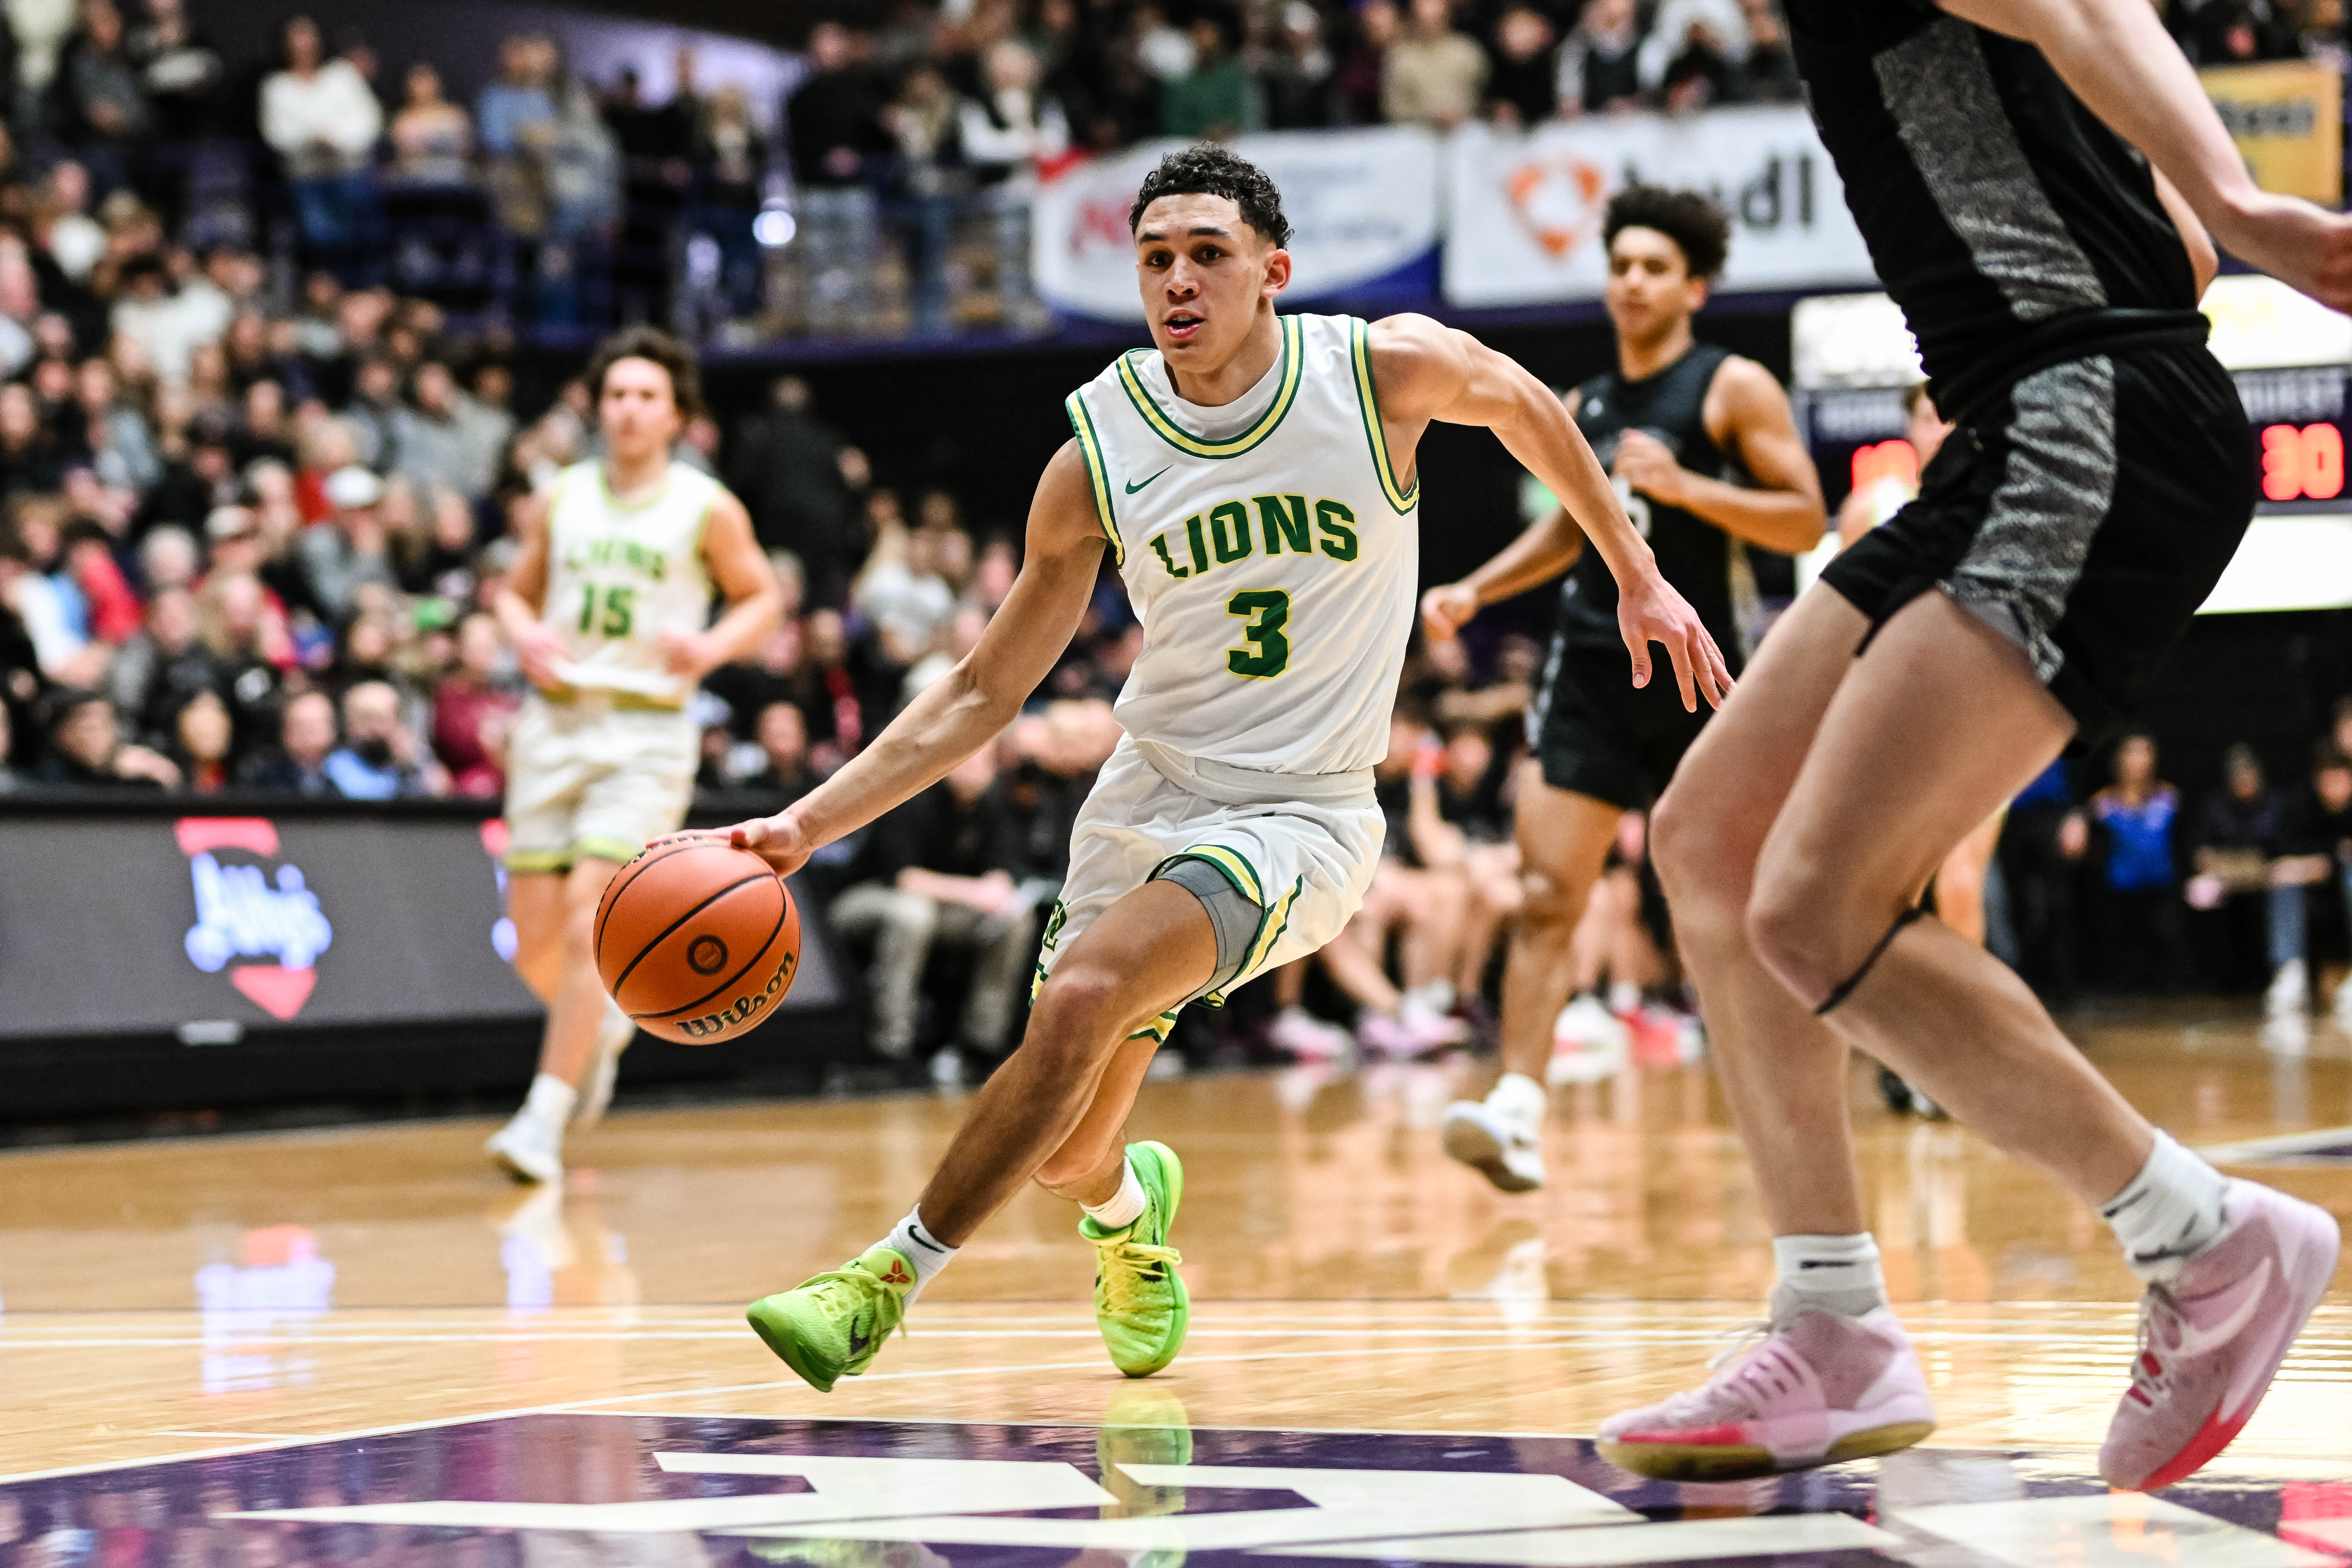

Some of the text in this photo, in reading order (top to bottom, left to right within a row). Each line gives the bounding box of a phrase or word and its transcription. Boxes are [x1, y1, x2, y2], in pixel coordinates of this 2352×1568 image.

[1621, 151, 1816, 232] dl
[1149, 493, 1360, 579] LIONS
[578, 583, 634, 637] 15
[1225, 588, 1292, 680] 3
[675, 950, 795, 1038] Wilson
